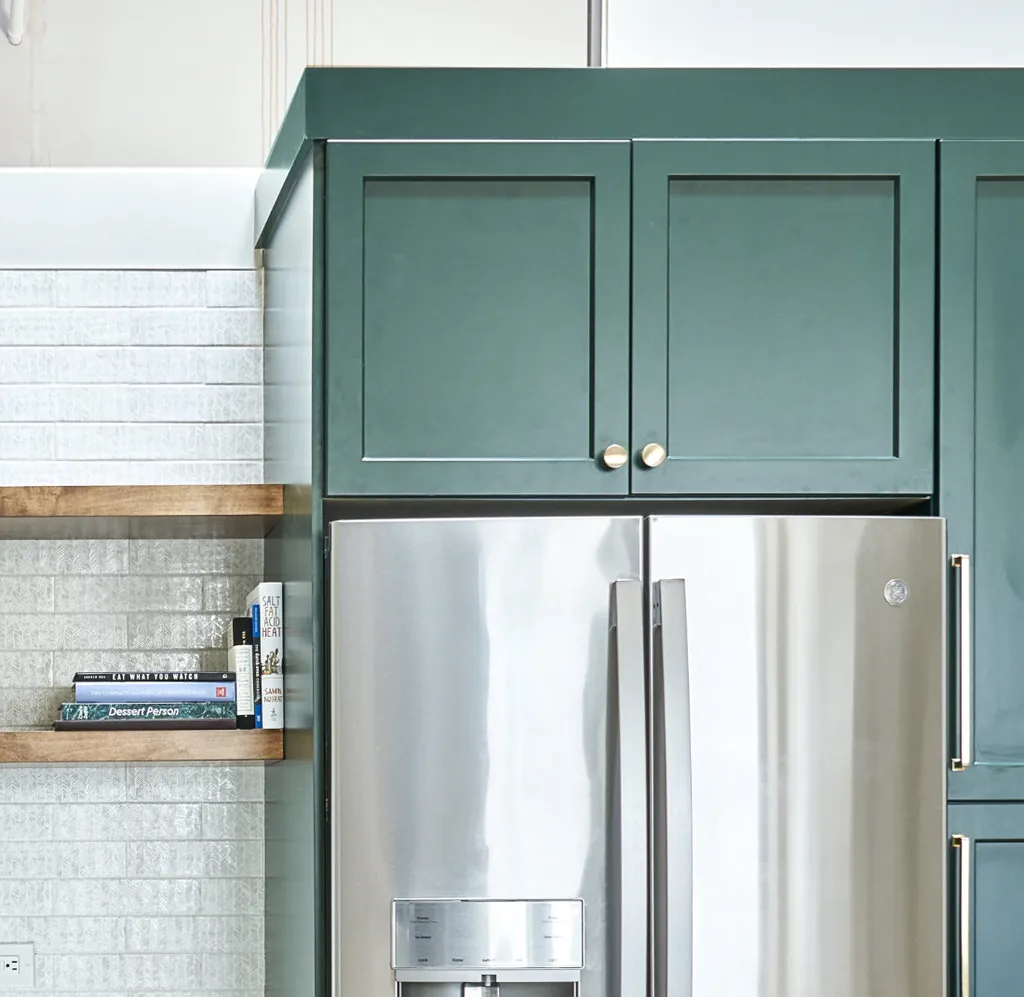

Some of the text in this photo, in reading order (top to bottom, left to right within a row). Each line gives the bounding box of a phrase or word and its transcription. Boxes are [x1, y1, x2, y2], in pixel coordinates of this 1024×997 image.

[262, 596, 281, 606] SALT
[264, 606, 278, 616] FAT
[264, 616, 280, 627] ACID
[262, 627, 281, 638] HEAT
[109, 707, 179, 716] Dessert Person
